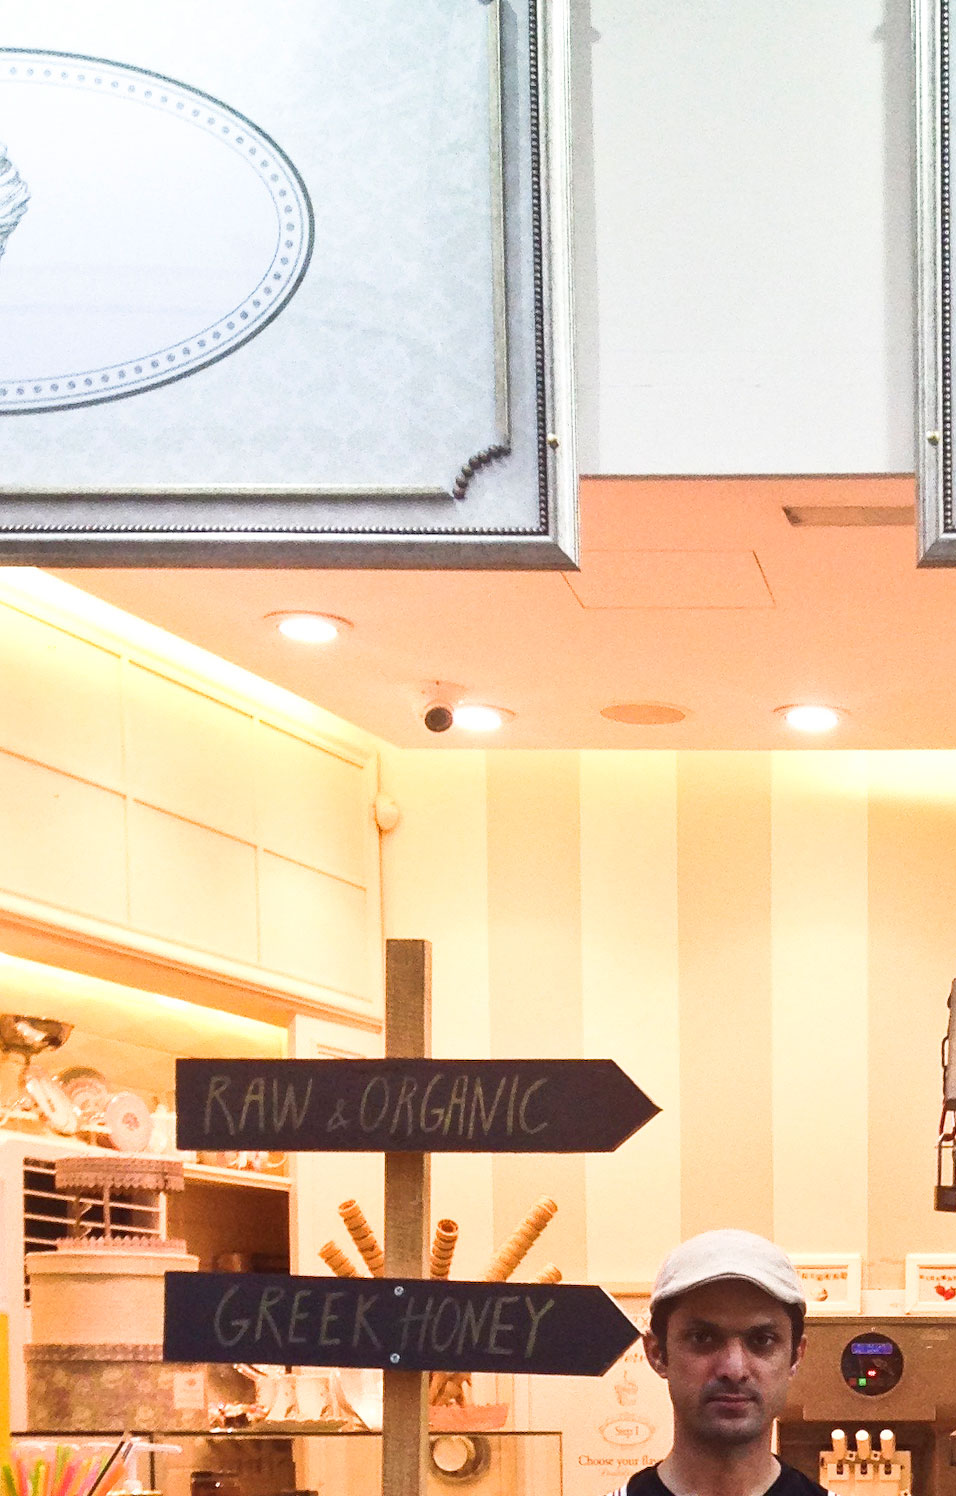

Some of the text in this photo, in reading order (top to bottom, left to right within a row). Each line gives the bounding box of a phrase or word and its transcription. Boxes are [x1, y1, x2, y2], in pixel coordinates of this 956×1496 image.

[203, 1073, 549, 1139] RAW & ORGANIC
[213, 1284, 555, 1358] GREEK HONEY
[578, 1455, 613, 1466] Choose
[616, 1458, 639, 1470] your
